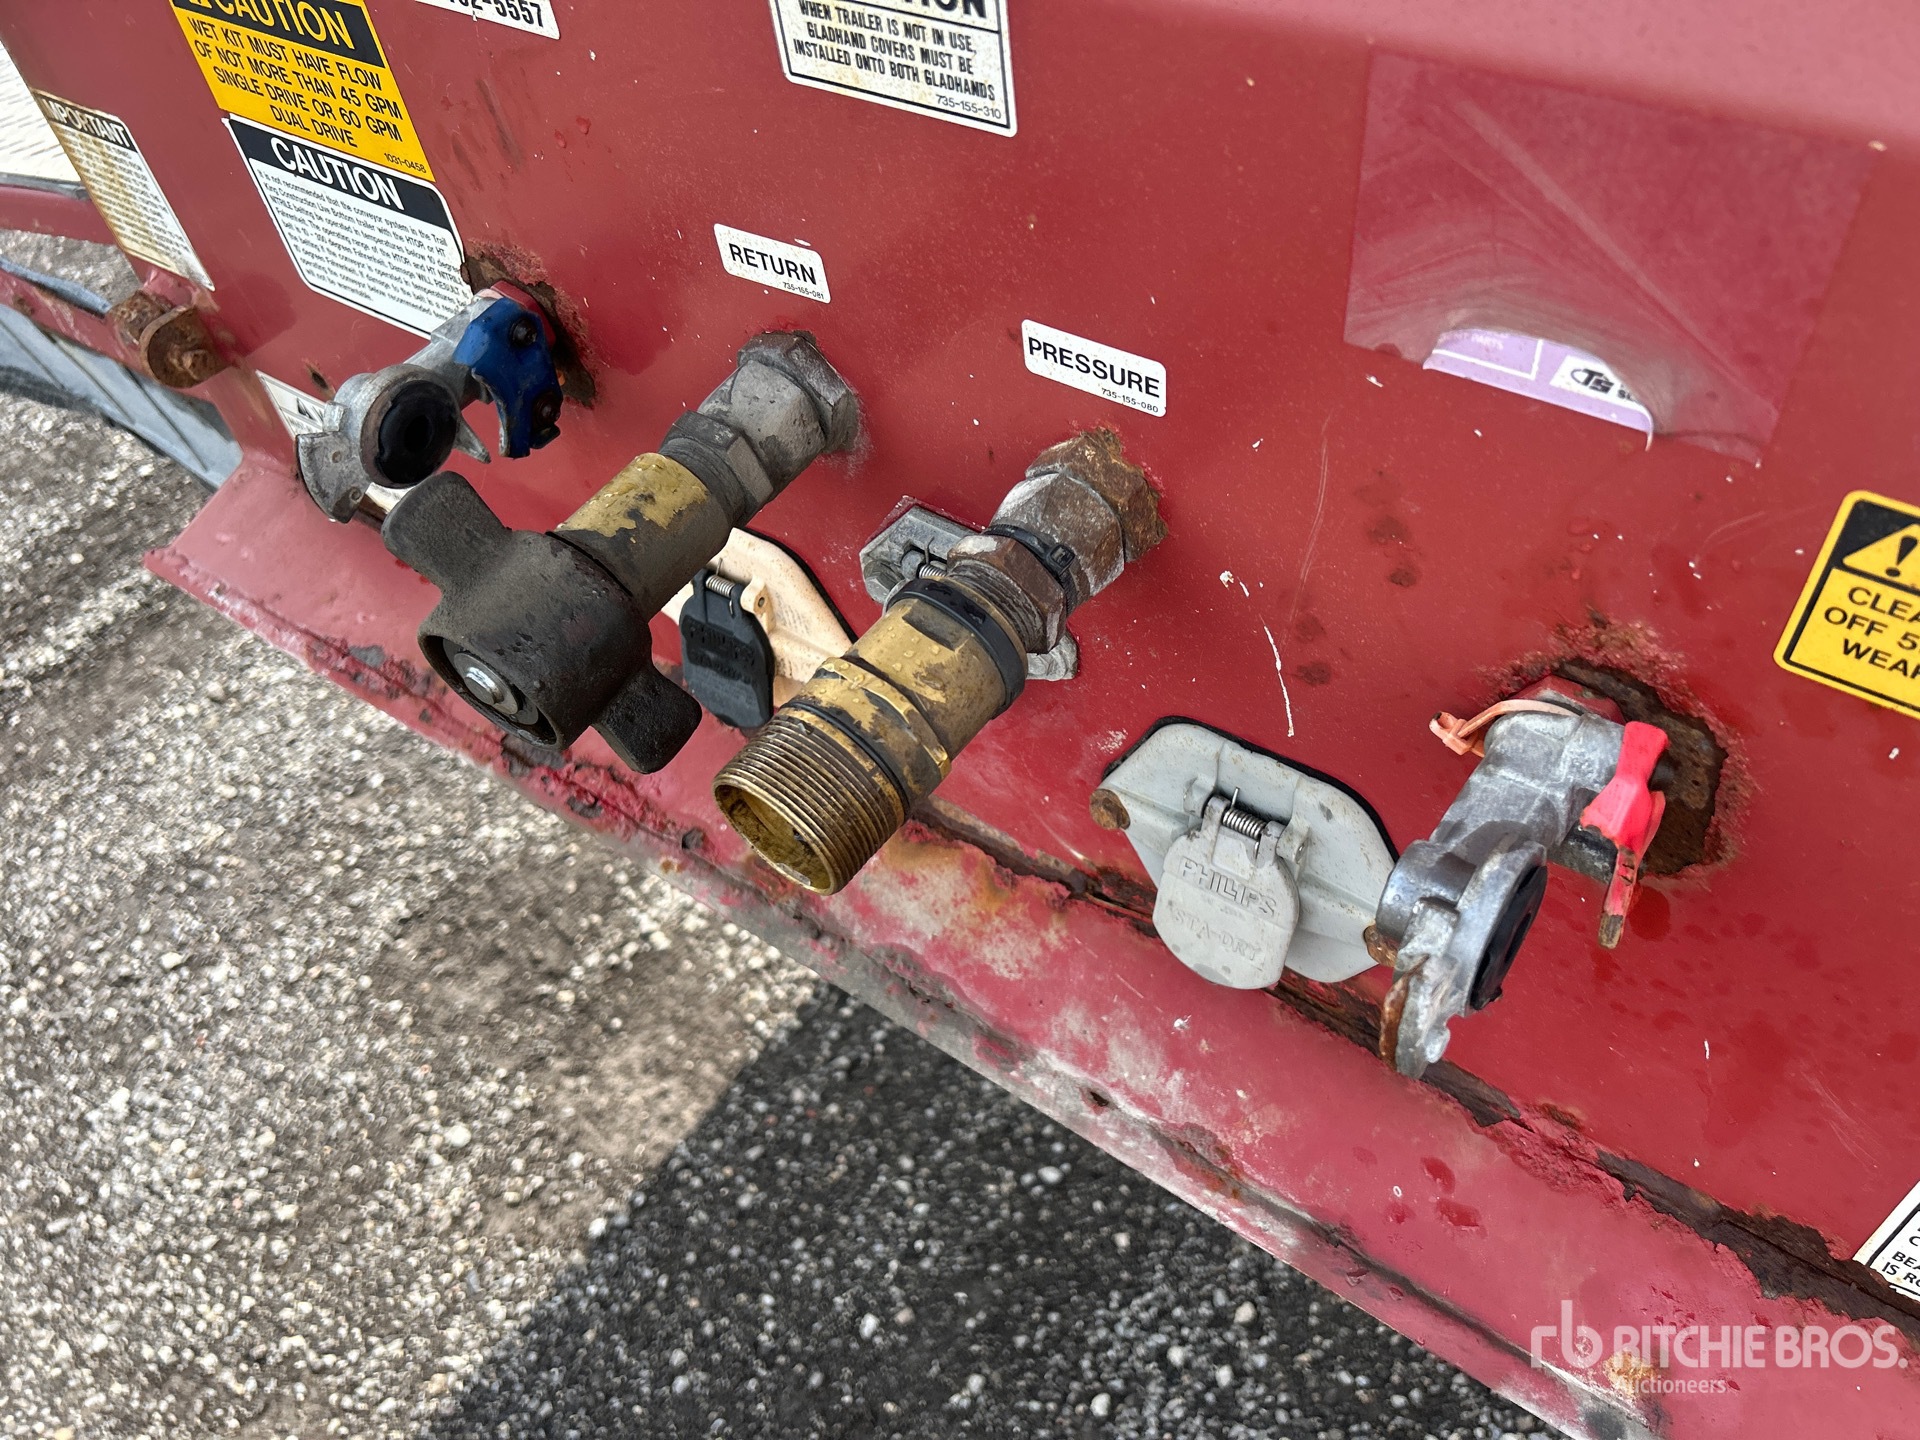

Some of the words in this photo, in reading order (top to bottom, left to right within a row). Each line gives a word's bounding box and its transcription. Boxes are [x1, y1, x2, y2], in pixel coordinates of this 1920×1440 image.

[450, 0, 544, 27] -5557
[799, 1, 832, 21] WHEN
[835, 7, 883, 33] TRAILER
[887, 18, 900, 36] IS
[904, 22, 927, 42] NOT
[932, 28, 945, 47] IN
[949, 32, 977, 55] USE,
[187, 16, 219, 41] WET
[221, 28, 244, 49] KIT
[247, 35, 289, 63] MUST
[295, 50, 331, 77] HAVE
[336, 61, 383, 91] FLOW
[793, 39, 851, 66] INSTALLED
[855, 53, 886, 75] ONTO
[890, 61, 920, 83] BOTH
[924, 70, 995, 101] GLADHANDS
[806, 21, 866, 50] GLADHAND
[870, 36, 916, 62] COVERS
[920, 47, 953, 70] MUST
[958, 58, 974, 75] BE
[194, 40, 213, 59] OF
[219, 46, 245, 68] NOT
[247, 56, 293, 86] MORE
[292, 71, 337, 100] THAN
[340, 85, 361, 107] 45
[365, 94, 403, 120] GPM
[213, 66, 264, 97] SINGLE
[266, 84, 310, 112] DRIVE
[311, 98, 335, 121] OR
[338, 107, 361, 129] 60
[365, 117, 403, 143] GPM
[935, 94, 1001, 120] 735-155-310
[40, 97, 131, 147] MPORTANT
[269, 104, 311, 133] DUAL
[311, 119, 358, 148] DRIVE
[270, 137, 405, 211] CAUTION
[384, 152, 427, 174] 1031-0458
[263, 181, 279, 195] King
[277, 187, 317, 208] Construction
[316, 202, 331, 214] Live
[329, 207, 355, 223] Bottom
[354, 216, 376, 231] trailer
[375, 225, 392, 237] with
[391, 230, 405, 242] the
[270, 174, 282, 185] not
[281, 178, 326, 202] recommended
[324, 194, 340, 207] that
[339, 200, 353, 212] the
[352, 206, 384, 225] conveyor
[383, 216, 410, 235] system
[417, 228, 431, 241] the
[728, 243, 816, 285] RETURN
[782, 281, 825, 299] 735-155-081
[1028, 337, 1160, 398] PRESSURE
[1101, 387, 1159, 413] 735-155-080
[1824, 607, 1888, 637] OFF
[1897, 631, 1920, 652] 5
[1180, 857, 1277, 917] PHILLIPS
[1882, 1262, 1899, 1275] IS
